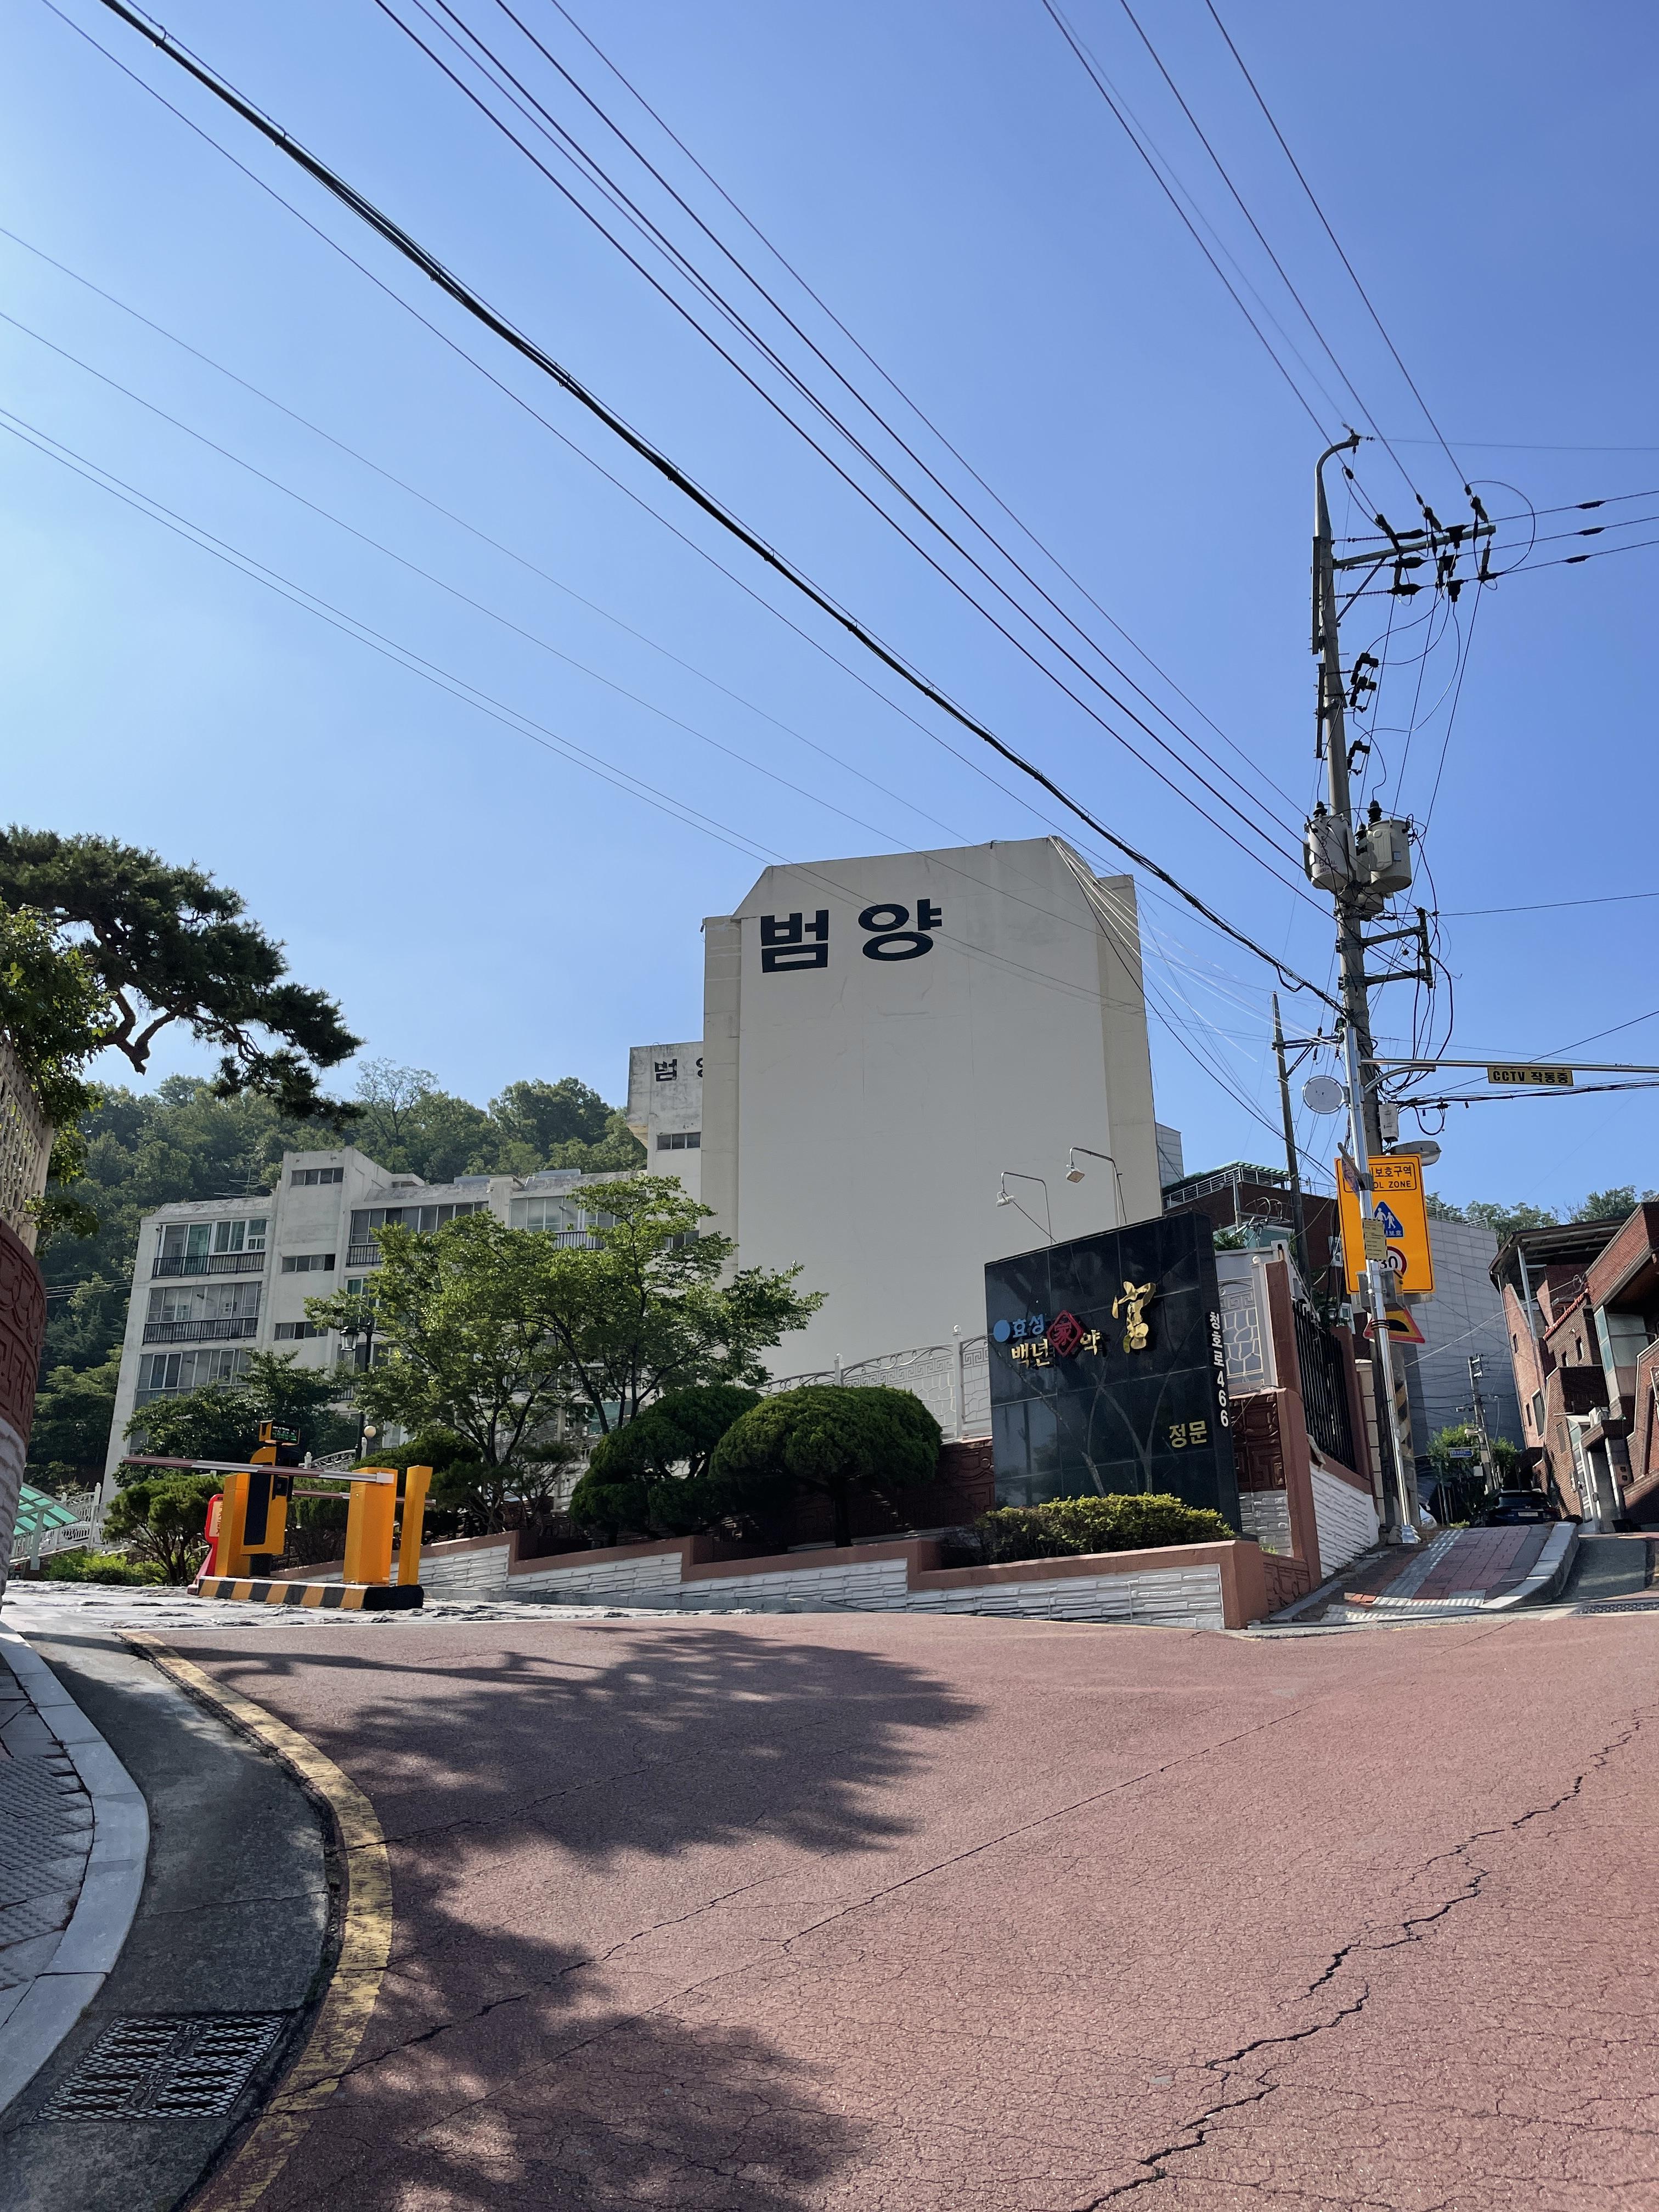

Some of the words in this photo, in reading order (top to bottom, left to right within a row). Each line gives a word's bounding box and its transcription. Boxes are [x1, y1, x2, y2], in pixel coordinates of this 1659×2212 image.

[654, 1058, 703, 1082] 범
[1493, 1070, 1525, 1082] CCTV
[1531, 1071, 1568, 1084] 작동중
[1370, 1165, 1412, 1177] 보호구역
[1389, 1180, 1412, 1188] ZONE
[1013, 1314, 1045, 1338] 효성
[1210, 1311, 1225, 1367] 청호로
[1217, 1370, 1229, 1427] 466
[1169, 1420, 1207, 1448] 정문
